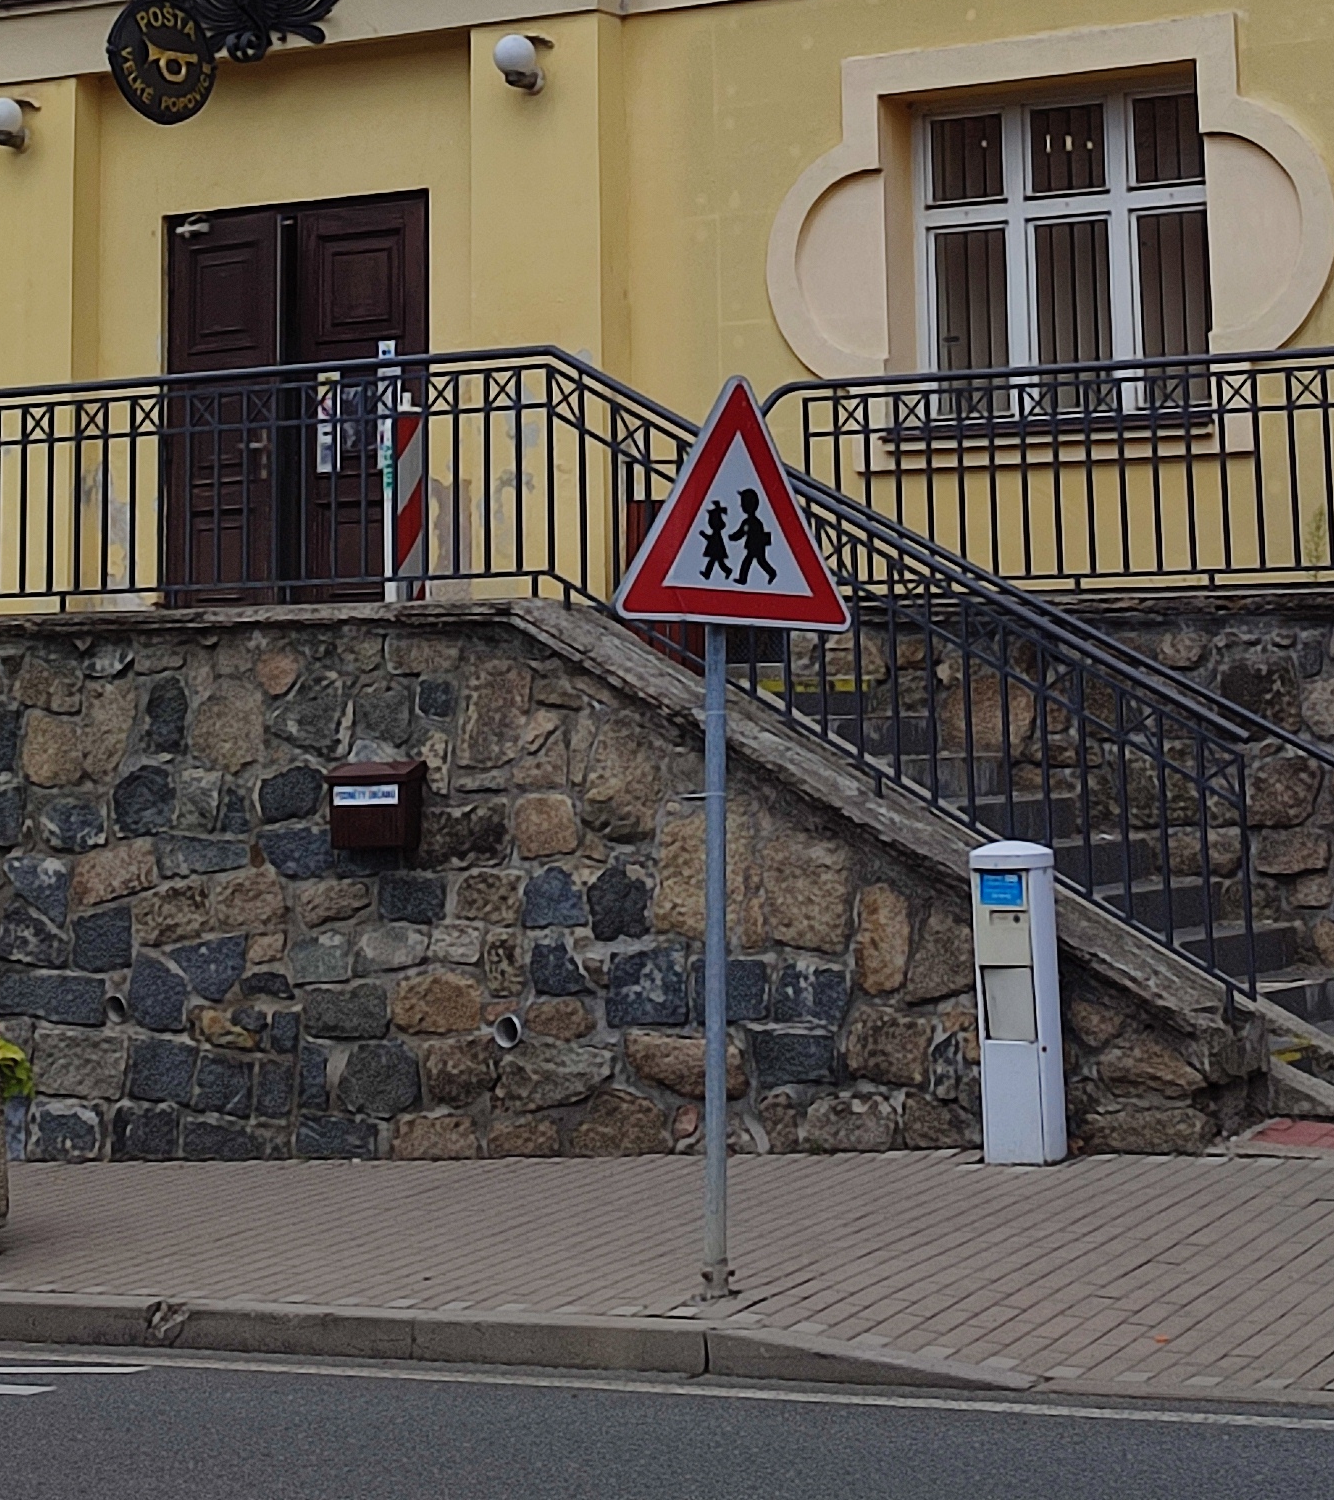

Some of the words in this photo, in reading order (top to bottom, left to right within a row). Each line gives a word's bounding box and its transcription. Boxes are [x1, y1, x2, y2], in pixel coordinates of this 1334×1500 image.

[136, 2, 196, 41] POŠTA
[121, 47, 154, 104] VELKÉ
[161, 62, 212, 112] POPOVICE
